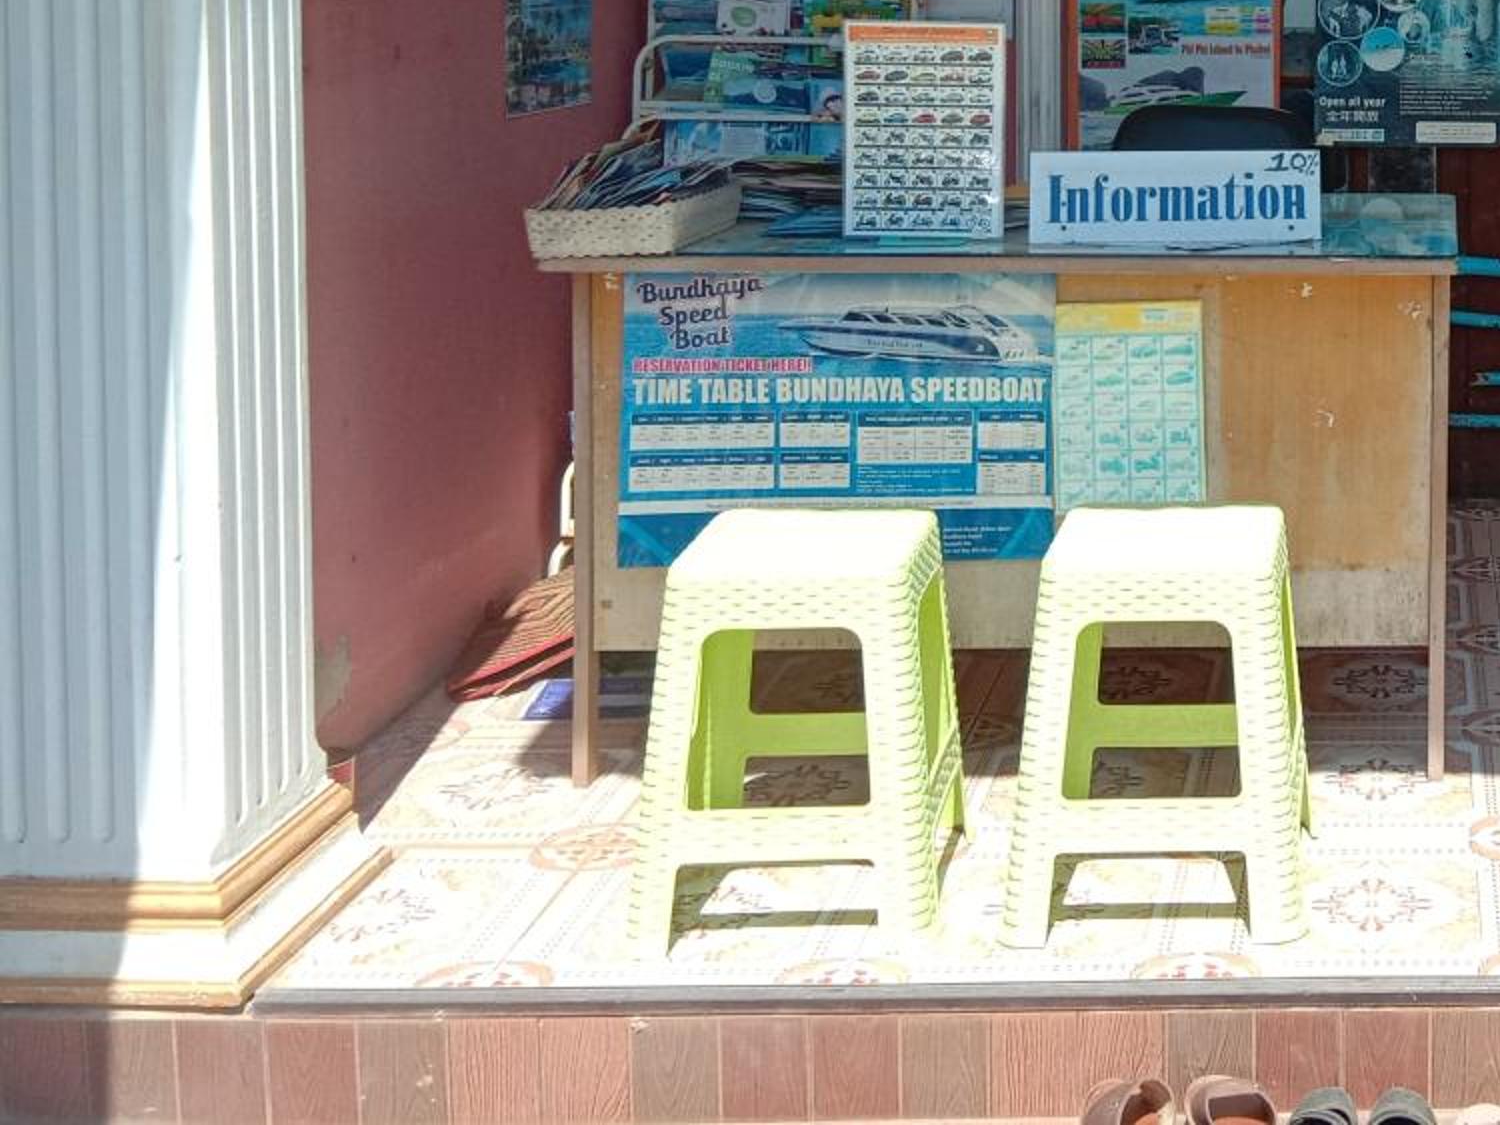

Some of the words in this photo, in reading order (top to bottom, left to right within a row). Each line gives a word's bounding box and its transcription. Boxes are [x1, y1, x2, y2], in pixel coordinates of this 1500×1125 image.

[1319, 97, 1346, 108] Open
[1363, 97, 1387, 109] year
[1047, 174, 1307, 224] Information
[636, 277, 764, 305] Bundhaya
[659, 296, 729, 326] Speed
[670, 325, 732, 352] Boat
[633, 378, 692, 405] TIME
[698, 378, 770, 404] TABLE
[775, 377, 905, 404] BUNDHAYA
[910, 376, 1049, 403] SPEEDBOAT
